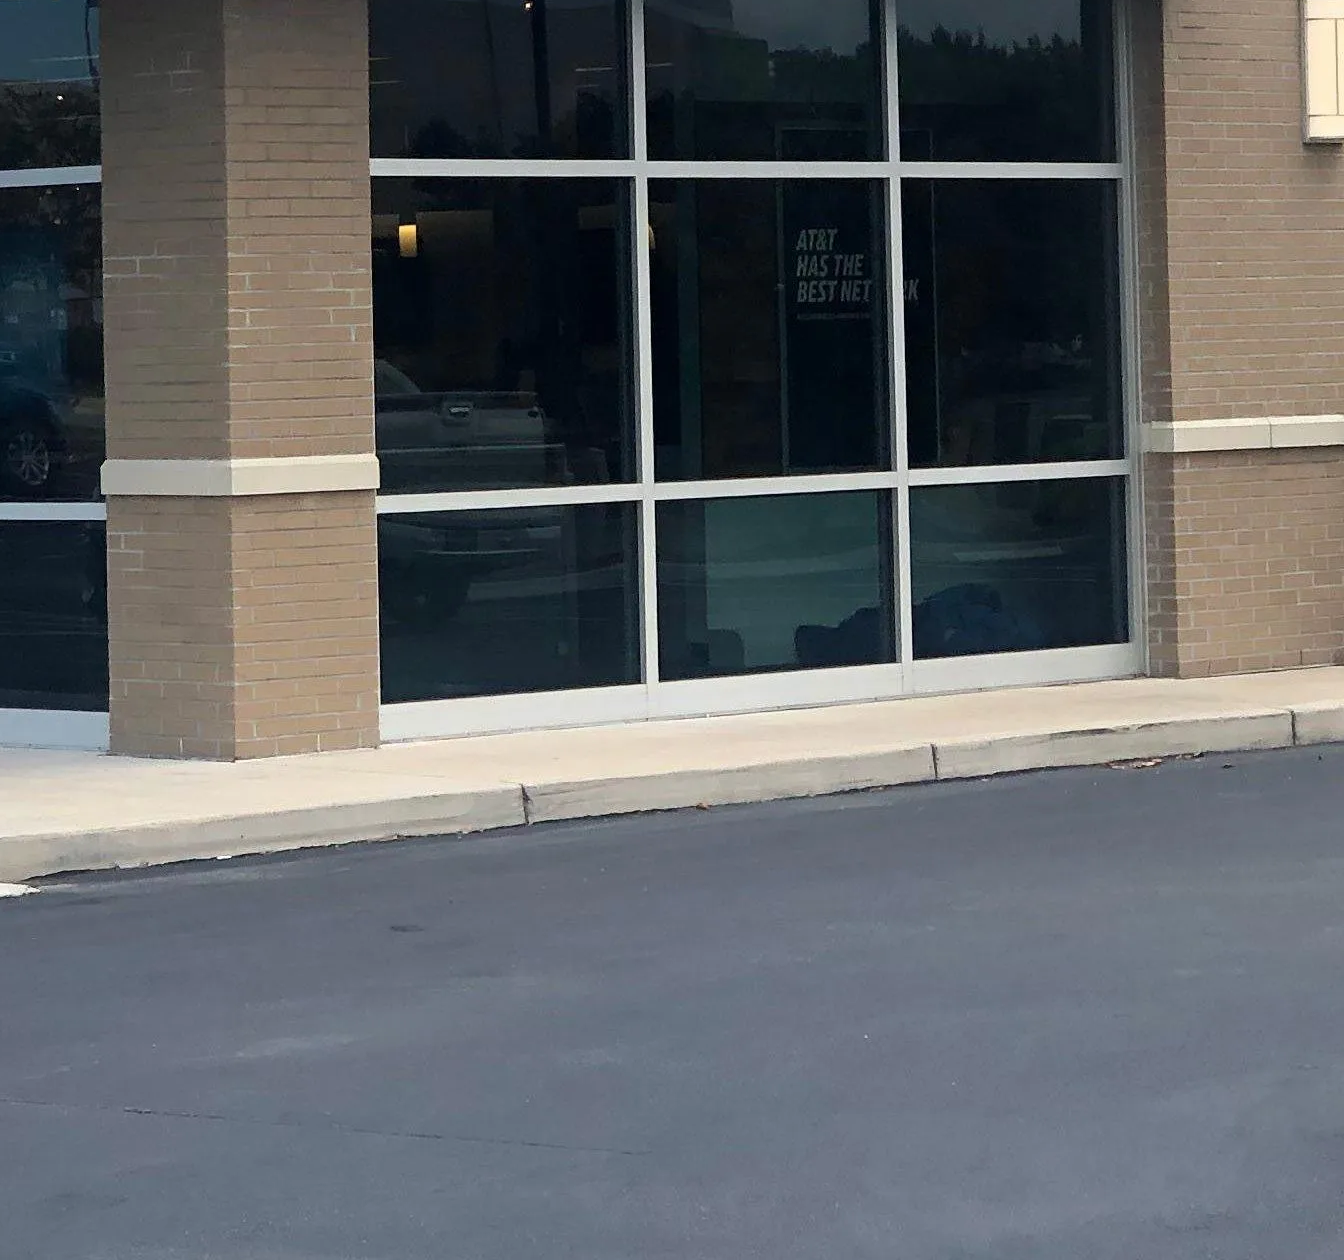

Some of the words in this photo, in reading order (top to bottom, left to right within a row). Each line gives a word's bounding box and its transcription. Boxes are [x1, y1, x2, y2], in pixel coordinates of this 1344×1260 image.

[796, 228, 838, 251] AT&T
[796, 254, 830, 277] HAS
[834, 254, 864, 276] THE
[797, 280, 838, 303] BEST
